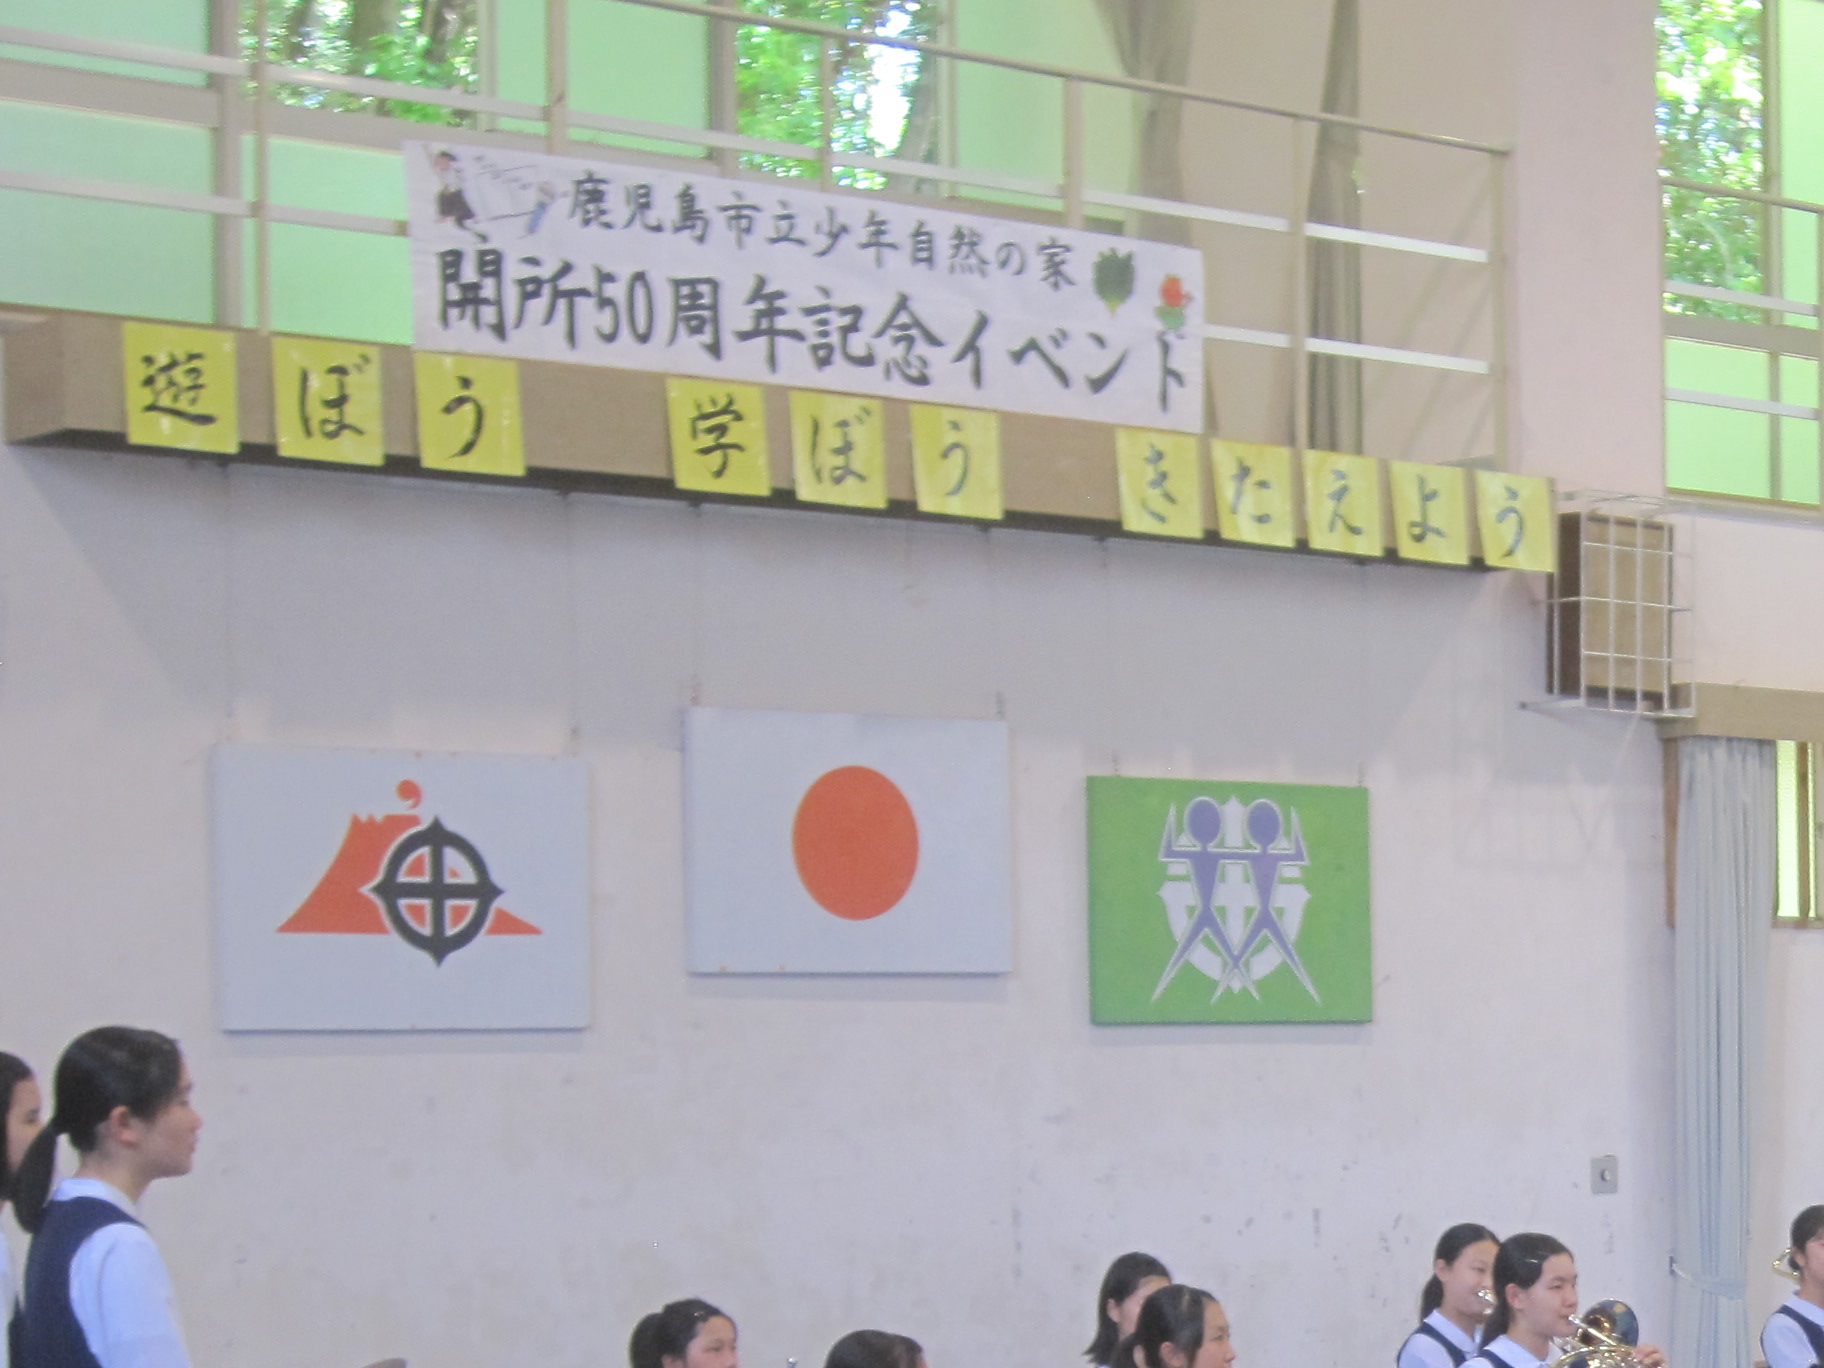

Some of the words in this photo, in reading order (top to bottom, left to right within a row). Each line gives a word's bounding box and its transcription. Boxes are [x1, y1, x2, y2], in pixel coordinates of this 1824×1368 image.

[568, 169, 1076, 292] 鹿児島市立少年自然の家
[437, 247, 1186, 413] 開所50周年記念イベント
[140, 353, 486, 458] 遊ぼう
[688, 392, 971, 496] 学ぼう
[1142, 443, 1523, 557] きたえよう
